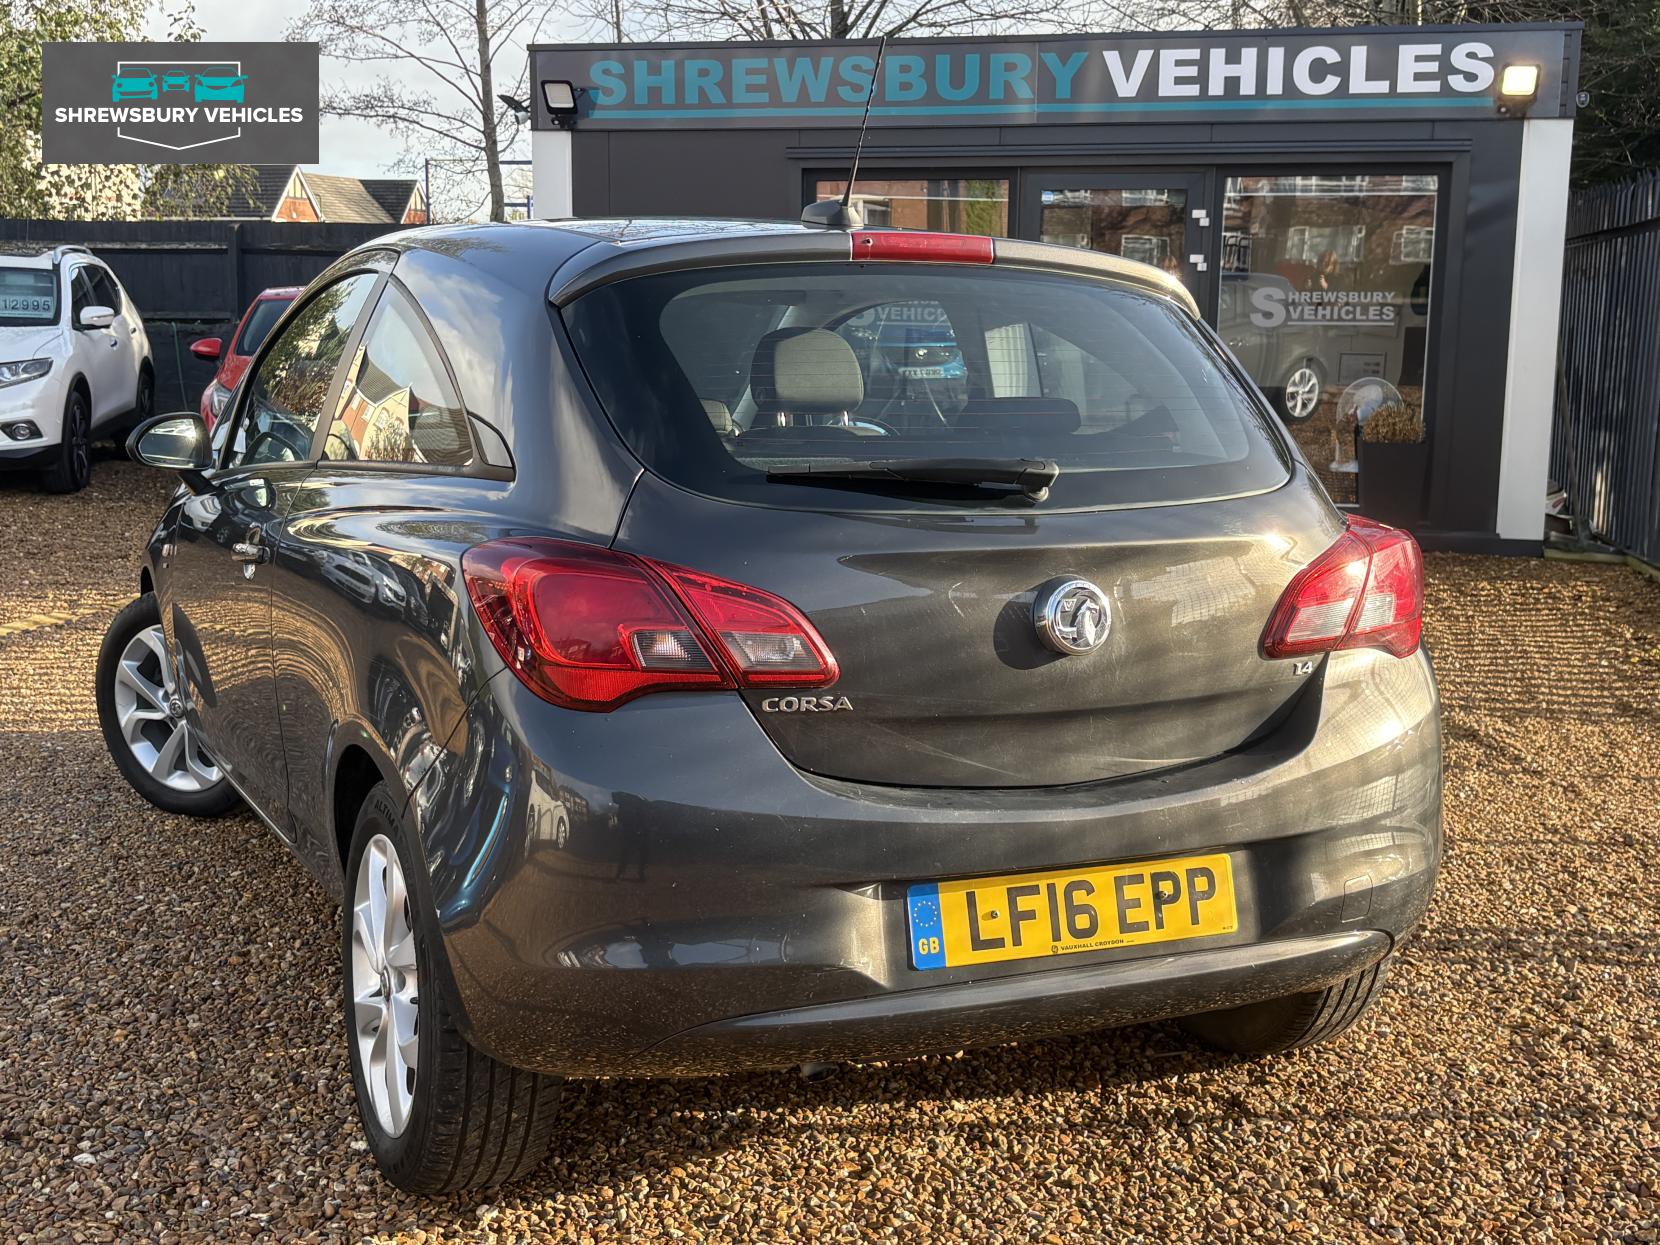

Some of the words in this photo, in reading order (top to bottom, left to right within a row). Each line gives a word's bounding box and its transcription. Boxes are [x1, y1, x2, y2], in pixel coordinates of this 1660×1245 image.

[589, 51, 1089, 107] SHREWSBURY
[1103, 42, 1495, 98] VEHICLES
[2, 299, 51, 311] 12995
[1289, 306, 1395, 320] VEHICLES
[762, 696, 853, 713] CORSA
[966, 879, 1099, 952] LF16
[1114, 866, 1216, 934] EPP
[918, 937, 940, 955] GB
[1061, 943, 1094, 951] VAUXHALL
[1095, 939, 1124, 947] CROYDON
